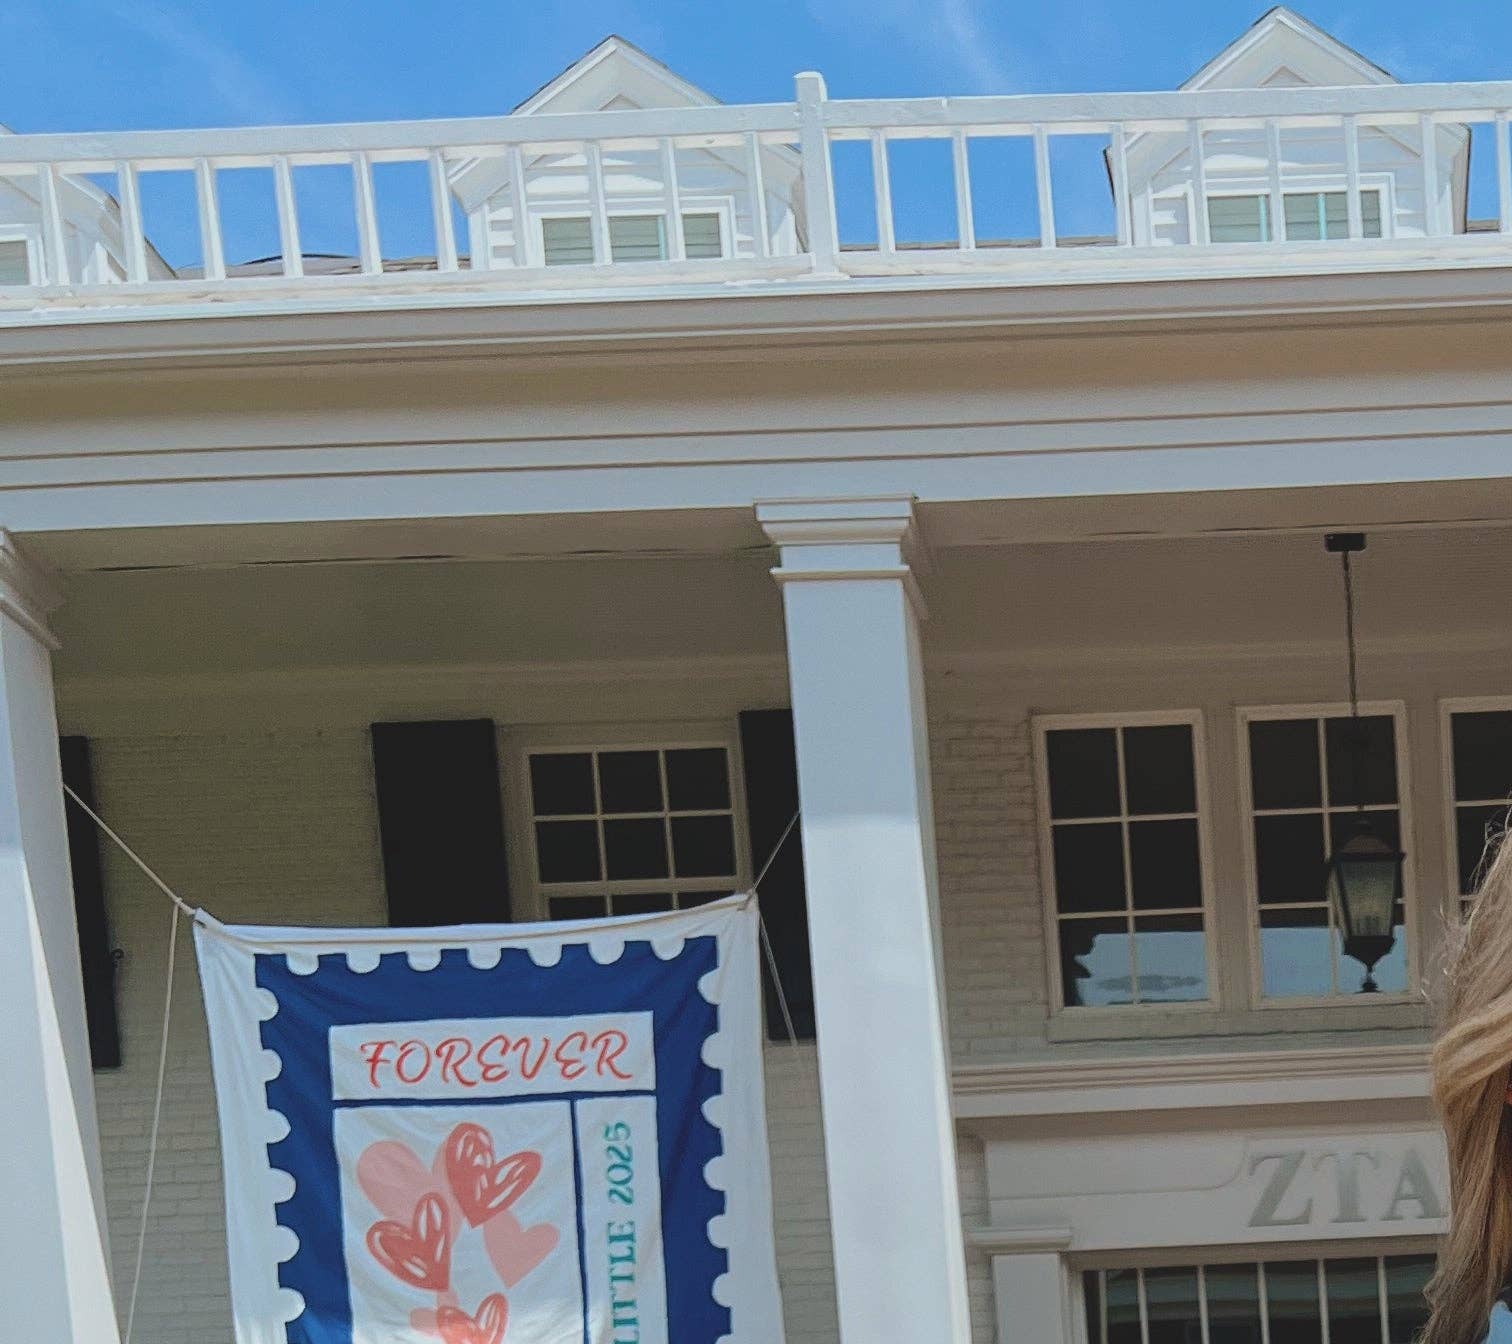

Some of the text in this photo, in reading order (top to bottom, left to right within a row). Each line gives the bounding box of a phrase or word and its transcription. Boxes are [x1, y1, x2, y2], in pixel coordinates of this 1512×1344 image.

[360, 1029, 633, 1088] FOREVER
[604, 1120, 635, 1206] 2025
[1247, 1147, 1448, 1228] ZTA
